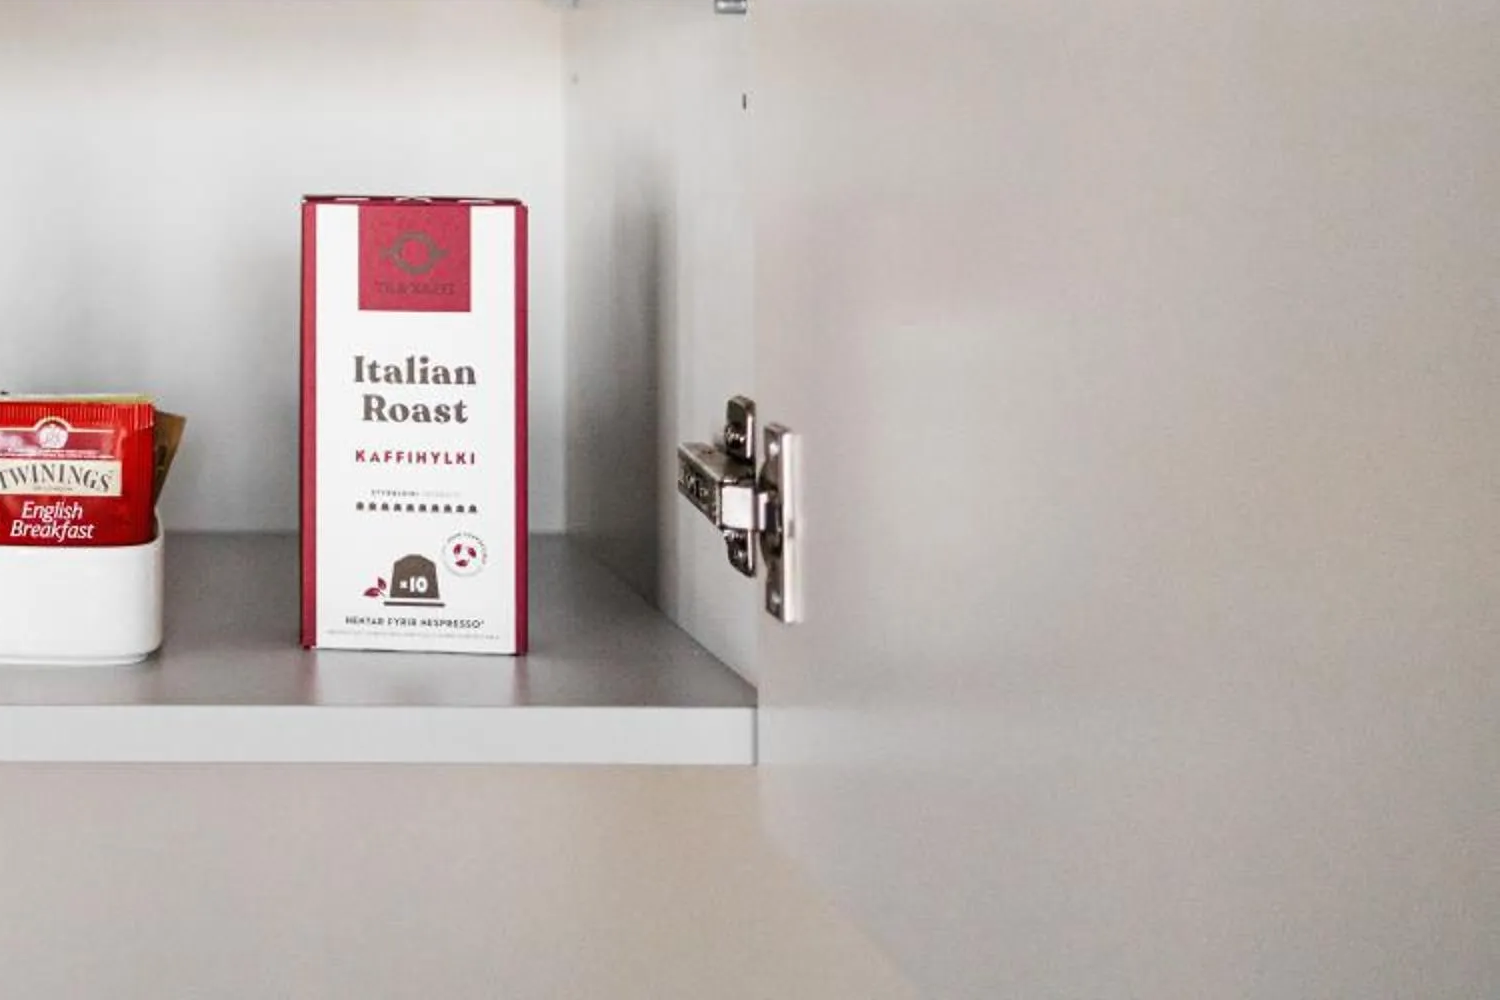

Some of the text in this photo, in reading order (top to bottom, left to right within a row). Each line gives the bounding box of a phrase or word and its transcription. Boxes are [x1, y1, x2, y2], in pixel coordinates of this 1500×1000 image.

[353, 355, 476, 385] Italian
[362, 394, 468, 423] Roast
[355, 449, 476, 465] KAFFIHYLKI
[21, 501, 83, 523] English
[10, 522, 95, 541] Breakfast
